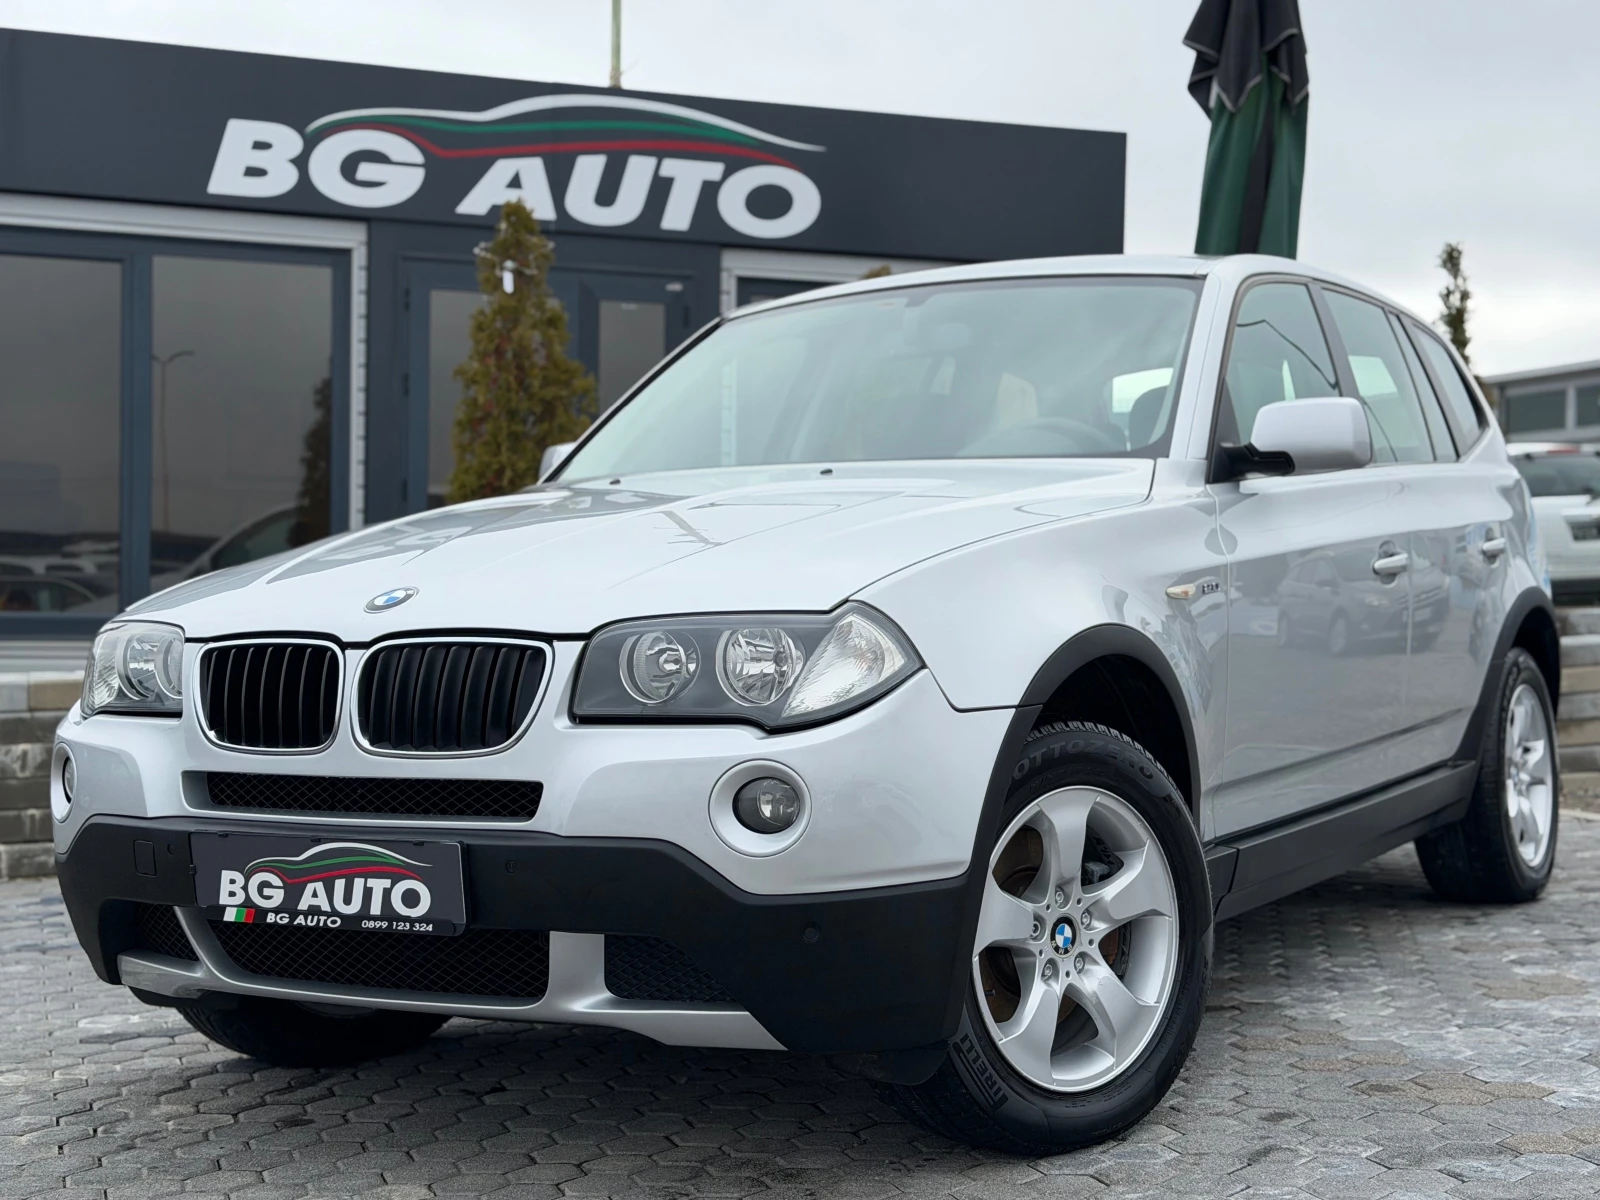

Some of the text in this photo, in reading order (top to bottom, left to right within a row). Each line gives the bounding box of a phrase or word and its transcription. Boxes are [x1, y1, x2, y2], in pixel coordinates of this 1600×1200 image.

[206, 118, 822, 239] BG AUTO
[218, 869, 432, 917] BG AUTO
[266, 912, 341, 928] BG AUTO
[361, 919, 433, 932] 0899 123 324
[952, 1032, 1009, 1112] PIRELLI
